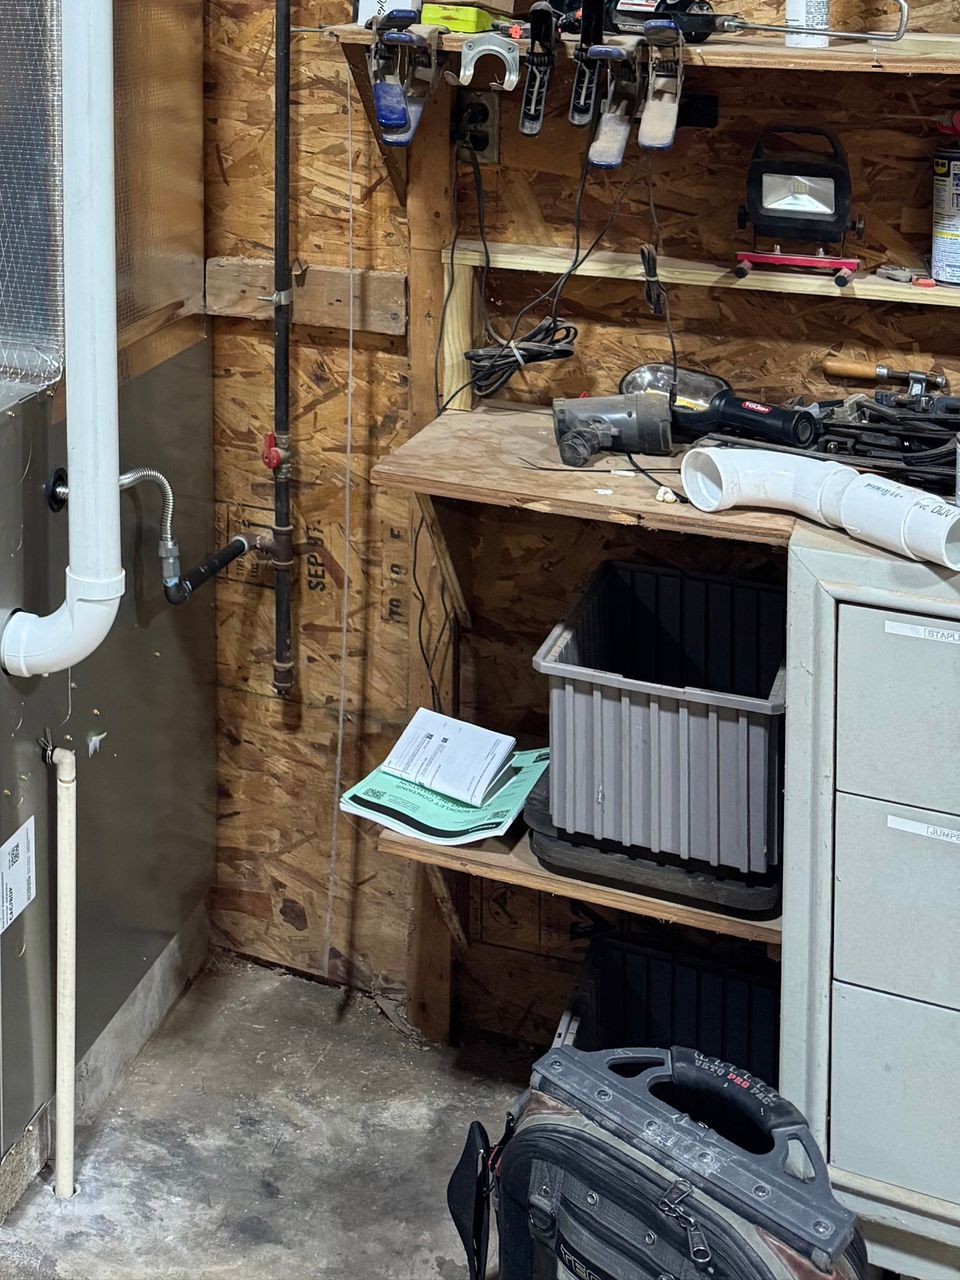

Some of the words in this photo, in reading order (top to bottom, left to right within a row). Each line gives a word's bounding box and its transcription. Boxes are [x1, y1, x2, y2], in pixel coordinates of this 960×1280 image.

[306, 553, 326, 593] SEP
[435, 801, 470, 814] BOOKLET
[694, 1058, 724, 1077] VETO
[726, 1071, 751, 1089] PRO
